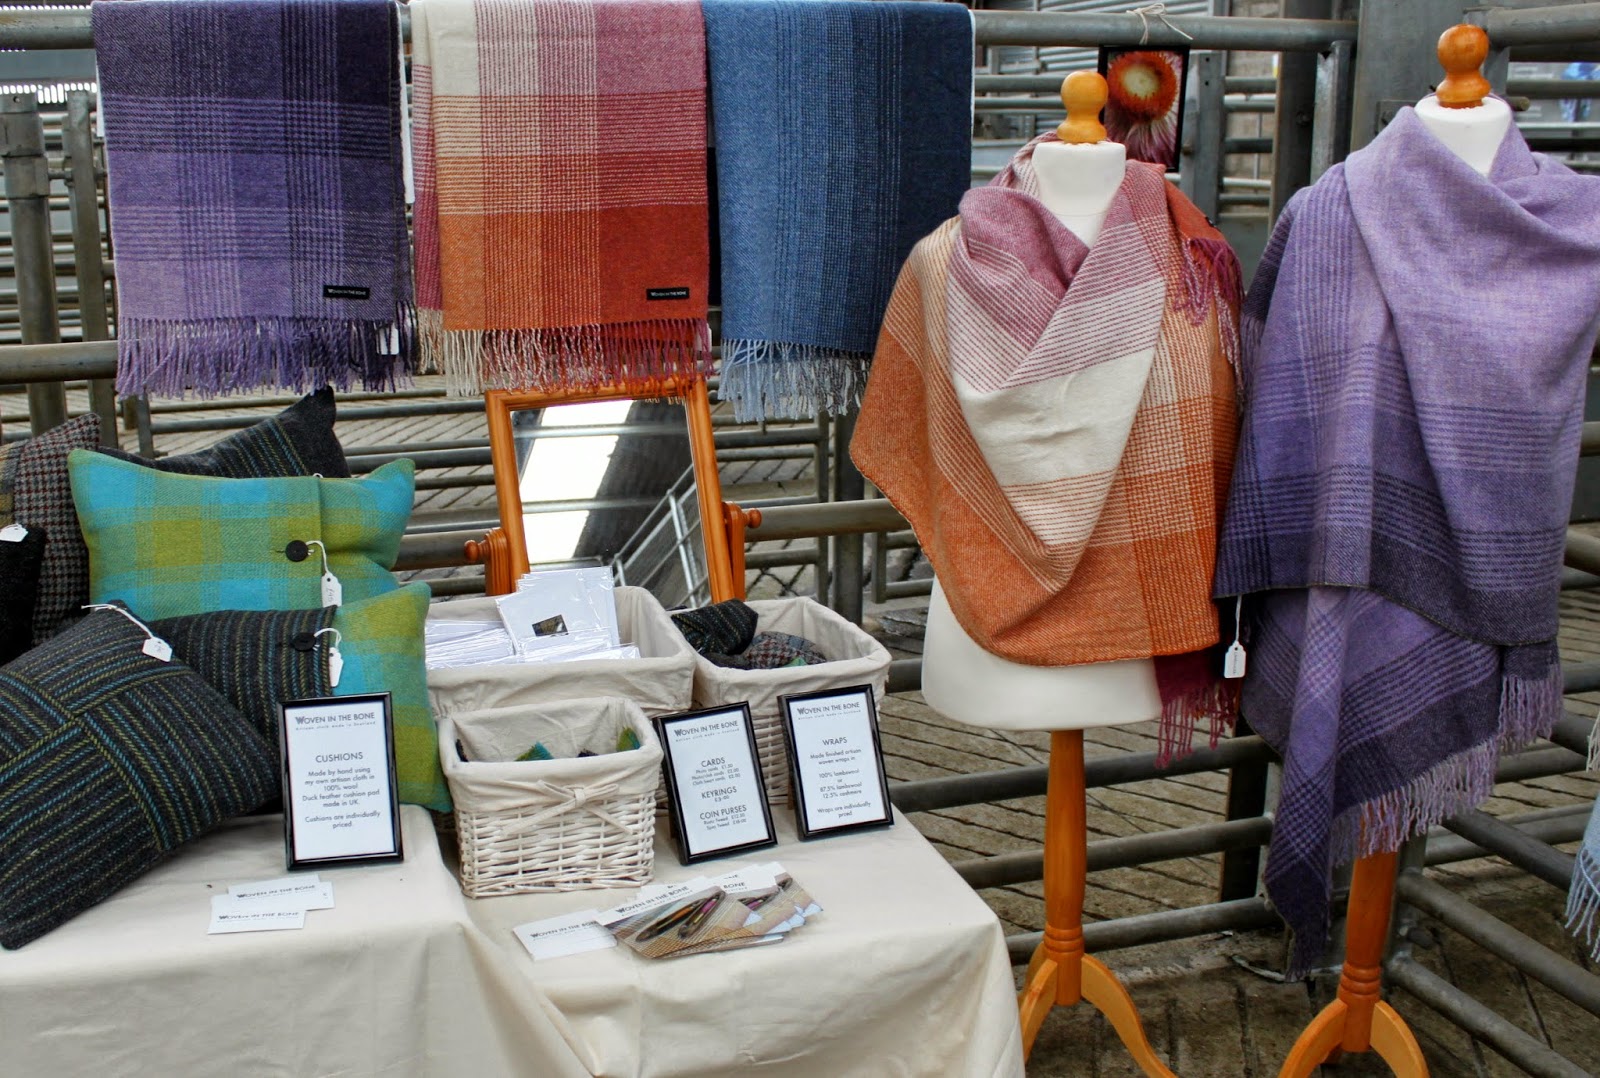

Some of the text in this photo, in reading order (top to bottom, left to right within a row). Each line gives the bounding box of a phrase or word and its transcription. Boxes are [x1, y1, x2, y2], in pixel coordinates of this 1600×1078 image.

[797, 707, 821, 715] WOVEN
[295, 716, 325, 724] WOVEN
[674, 728, 699, 737] WOVEN
[721, 720, 738, 728] BONE
[822, 737, 848, 745] WRAPS
[315, 752, 363, 763] CUSHIONS
[701, 757, 725, 767] CARDS
[834, 769, 860, 777] lambswool
[836, 782, 862, 790] lambswool
[701, 786, 737, 799] KEYRINGS
[844, 801, 871, 809] individually
[346, 810, 380, 819] individually
[700, 805, 747, 820] COIN PURSES
[332, 821, 352, 829] priced
[616, 903, 646, 913] WOVEN
[668, 886, 689, 895] BONE
[530, 930, 558, 938] WOVEN
